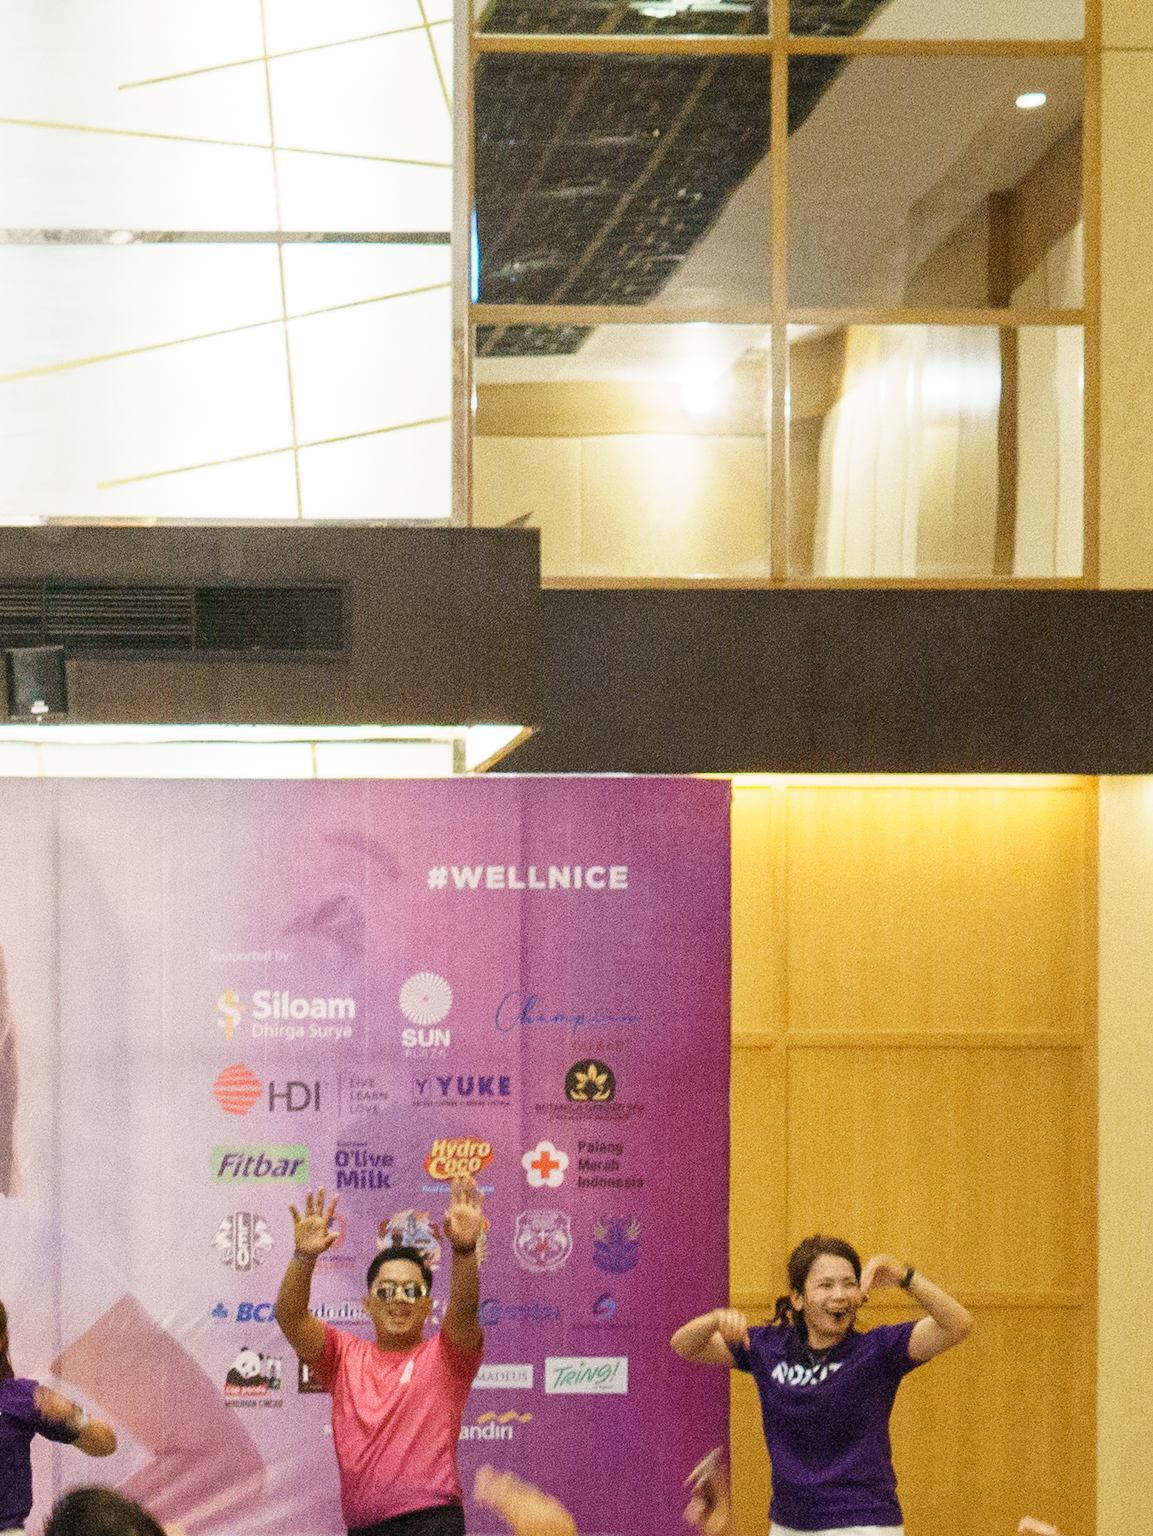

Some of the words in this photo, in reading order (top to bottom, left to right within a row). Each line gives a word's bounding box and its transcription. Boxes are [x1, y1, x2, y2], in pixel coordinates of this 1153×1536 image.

[427, 865, 629, 890] #WELLNICE
[252, 990, 356, 1019] Siloam
[252, 1023, 305, 1040] Dhirga
[309, 1023, 353, 1040] Surya
[401, 1029, 451, 1048] SUN
[268, 1080, 321, 1112] HDI
[437, 1076, 511, 1096] YUKE
[431, 1139, 491, 1161] Hydro
[577, 1140, 624, 1156] Palang
[217, 1151, 305, 1179] Fitbar
[428, 1157, 482, 1180] Coco
[577, 1159, 620, 1171] Merah
[336, 1169, 391, 1190] Milk
[577, 1175, 645, 1189] Indonesia
[237, 1214, 249, 1266] LEO
[458, 1422, 514, 1440] andiri
